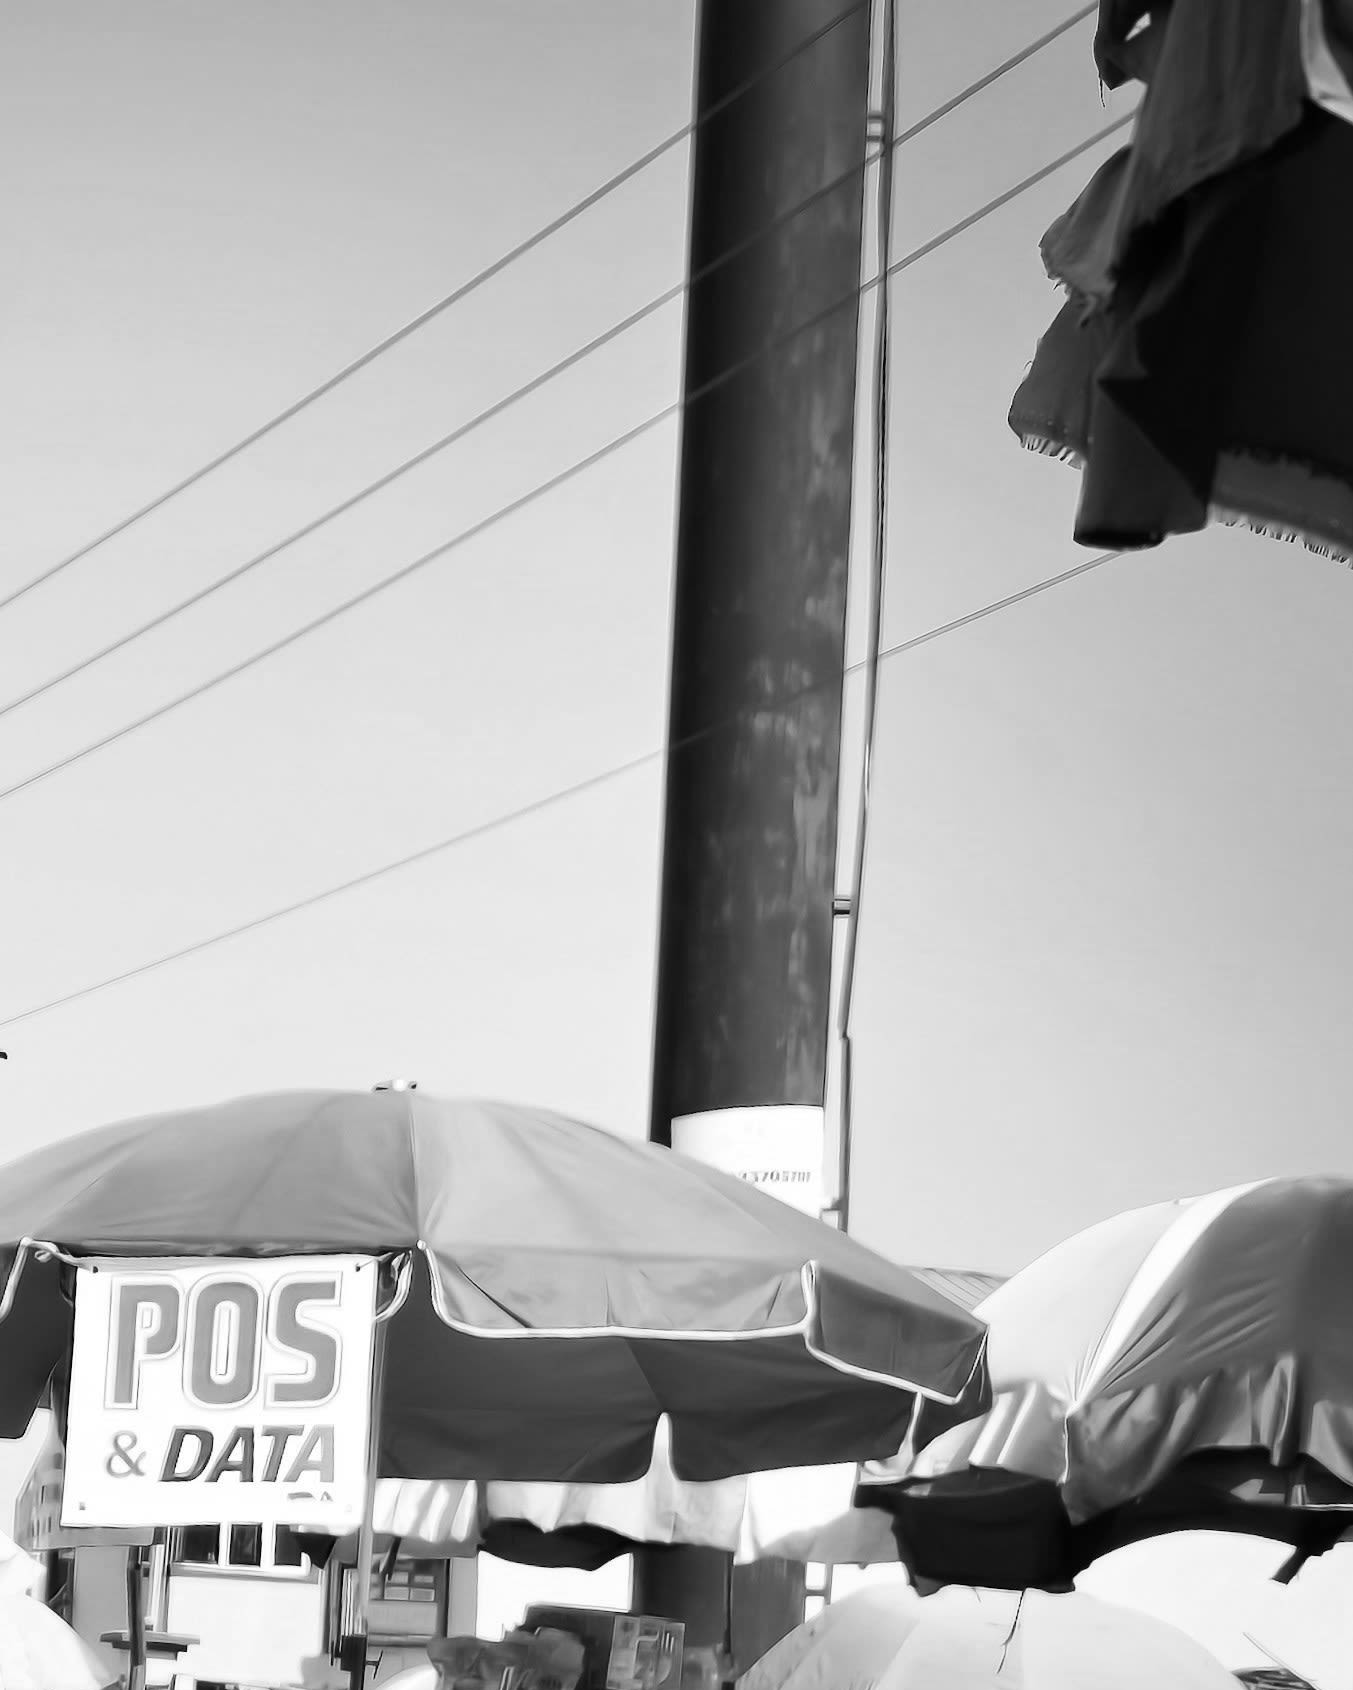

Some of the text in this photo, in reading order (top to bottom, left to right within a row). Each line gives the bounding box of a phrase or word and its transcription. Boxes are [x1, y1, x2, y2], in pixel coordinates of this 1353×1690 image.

[104, 1270, 344, 1410] POS
[105, 1424, 335, 1483] & DATA
